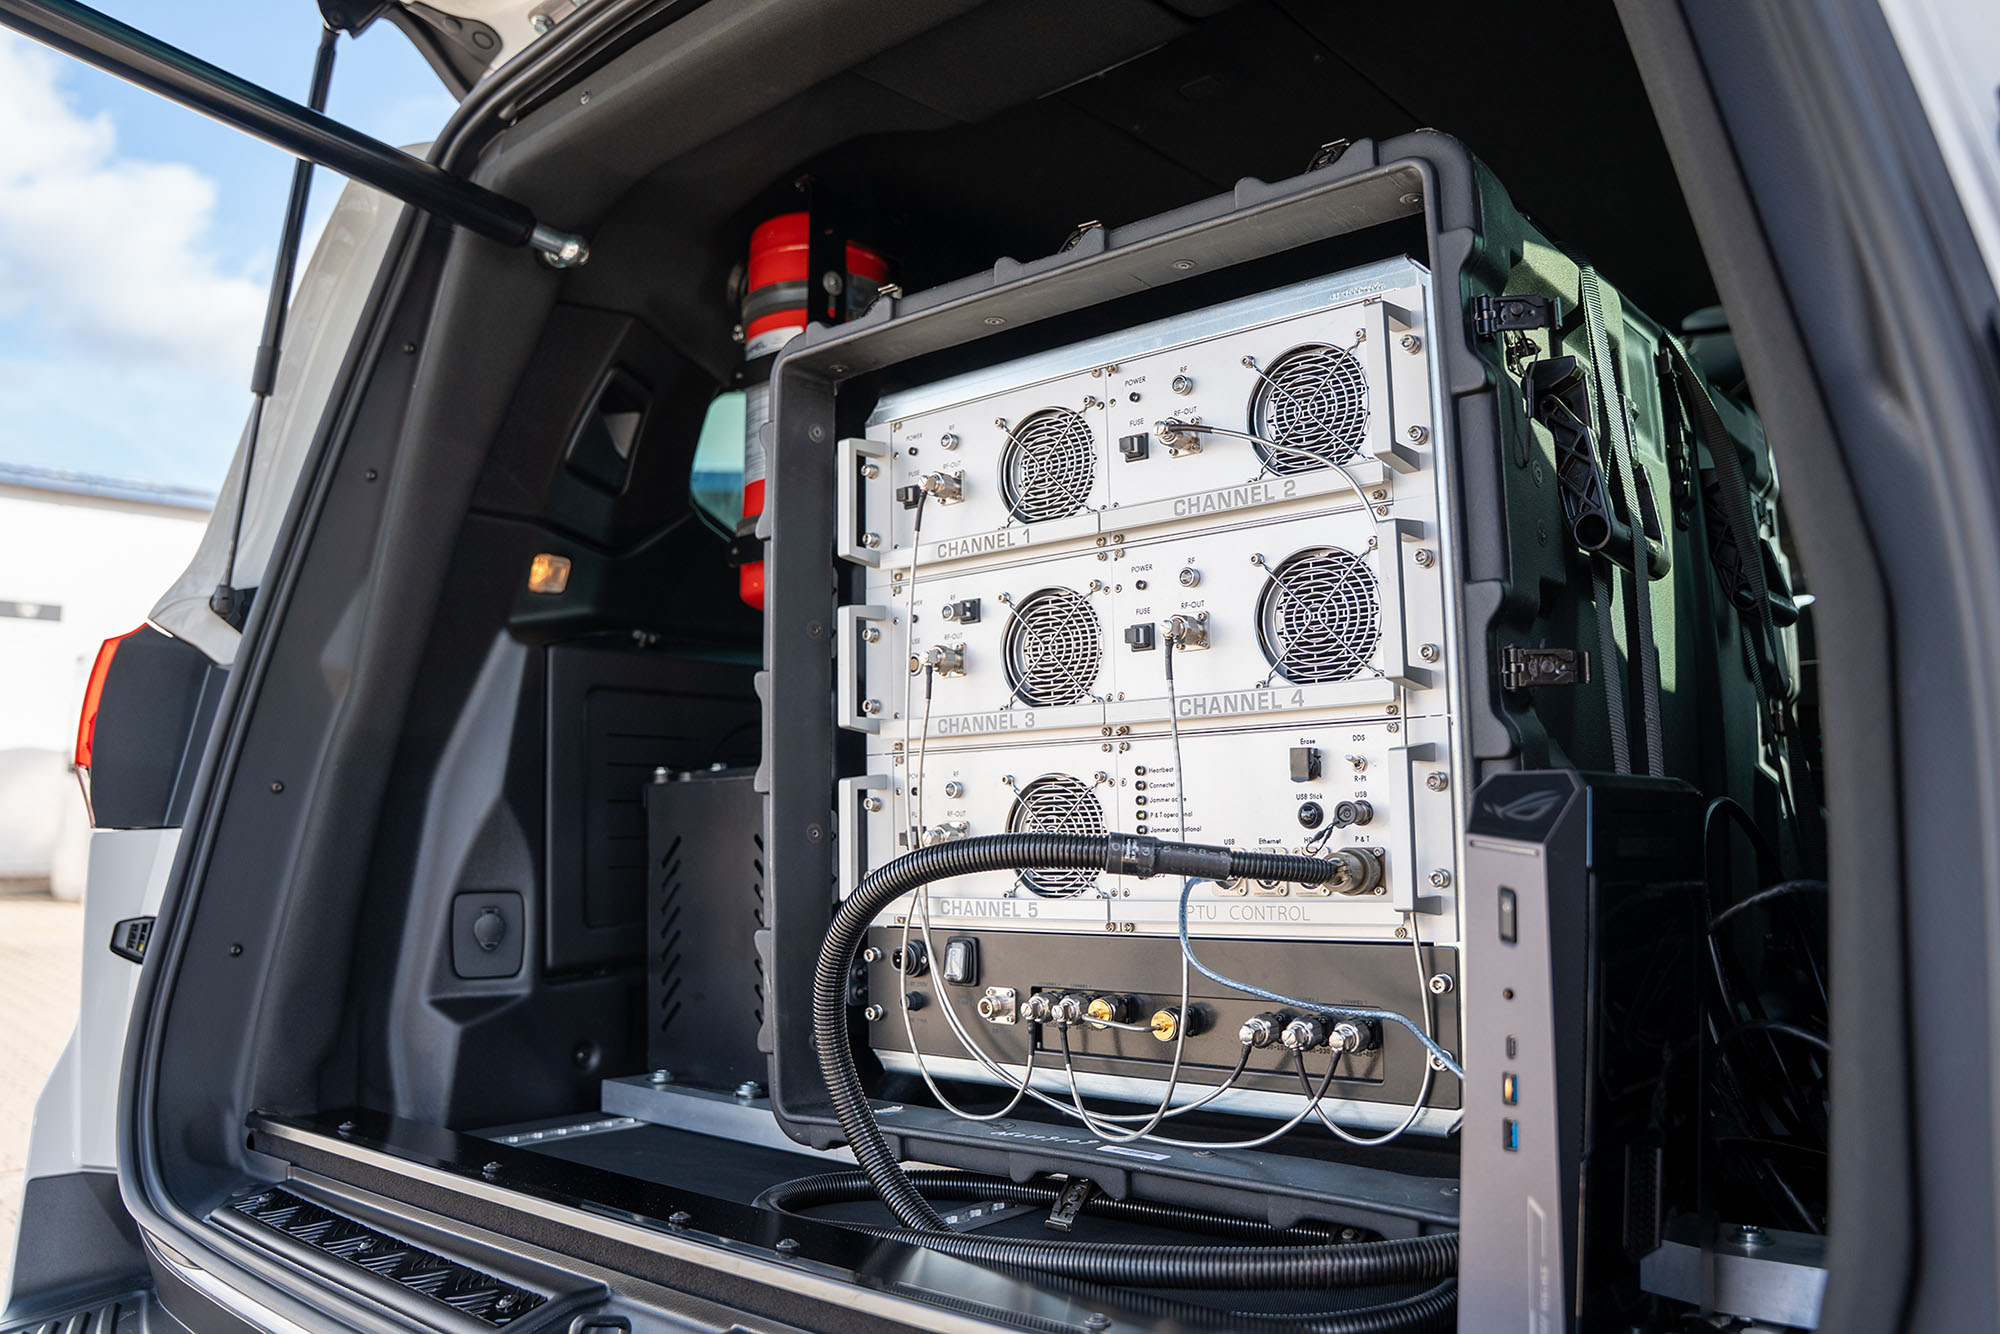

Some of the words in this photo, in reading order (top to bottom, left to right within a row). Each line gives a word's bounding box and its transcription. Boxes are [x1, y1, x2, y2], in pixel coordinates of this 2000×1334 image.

[1179, 365, 1188, 373] RF
[1125, 376, 1147, 387] POWER
[1173, 406, 1198, 417] RF-OUT
[1129, 417, 1144, 427] FUSE
[906, 432, 923, 441] POWER
[908, 470, 920, 478] FUSE
[1173, 483, 1276, 517] CHANNEL
[1283, 479, 1297, 498] 2
[937, 532, 1016, 559] CHANNEL
[1022, 528, 1031, 544] 1
[1187, 557, 1196, 565] RF
[1131, 563, 1153, 573] POWER
[1180, 600, 1205, 610] RF-OUT
[1135, 607, 1151, 616] FUSE
[1179, 691, 1283, 718] CHANNEL
[1290, 688, 1305, 708] 4
[937, 713, 1018, 734] CHANNEL
[1024, 711, 1036, 728] 3
[1300, 737, 1316, 745] Erase
[1352, 734, 1366, 742] DDS
[1355, 790, 1368, 798] USB
[939, 898, 1021, 918] CHANNEL
[1027, 901, 1039, 918] 5
[1229, 904, 1311, 921] CONTROL
